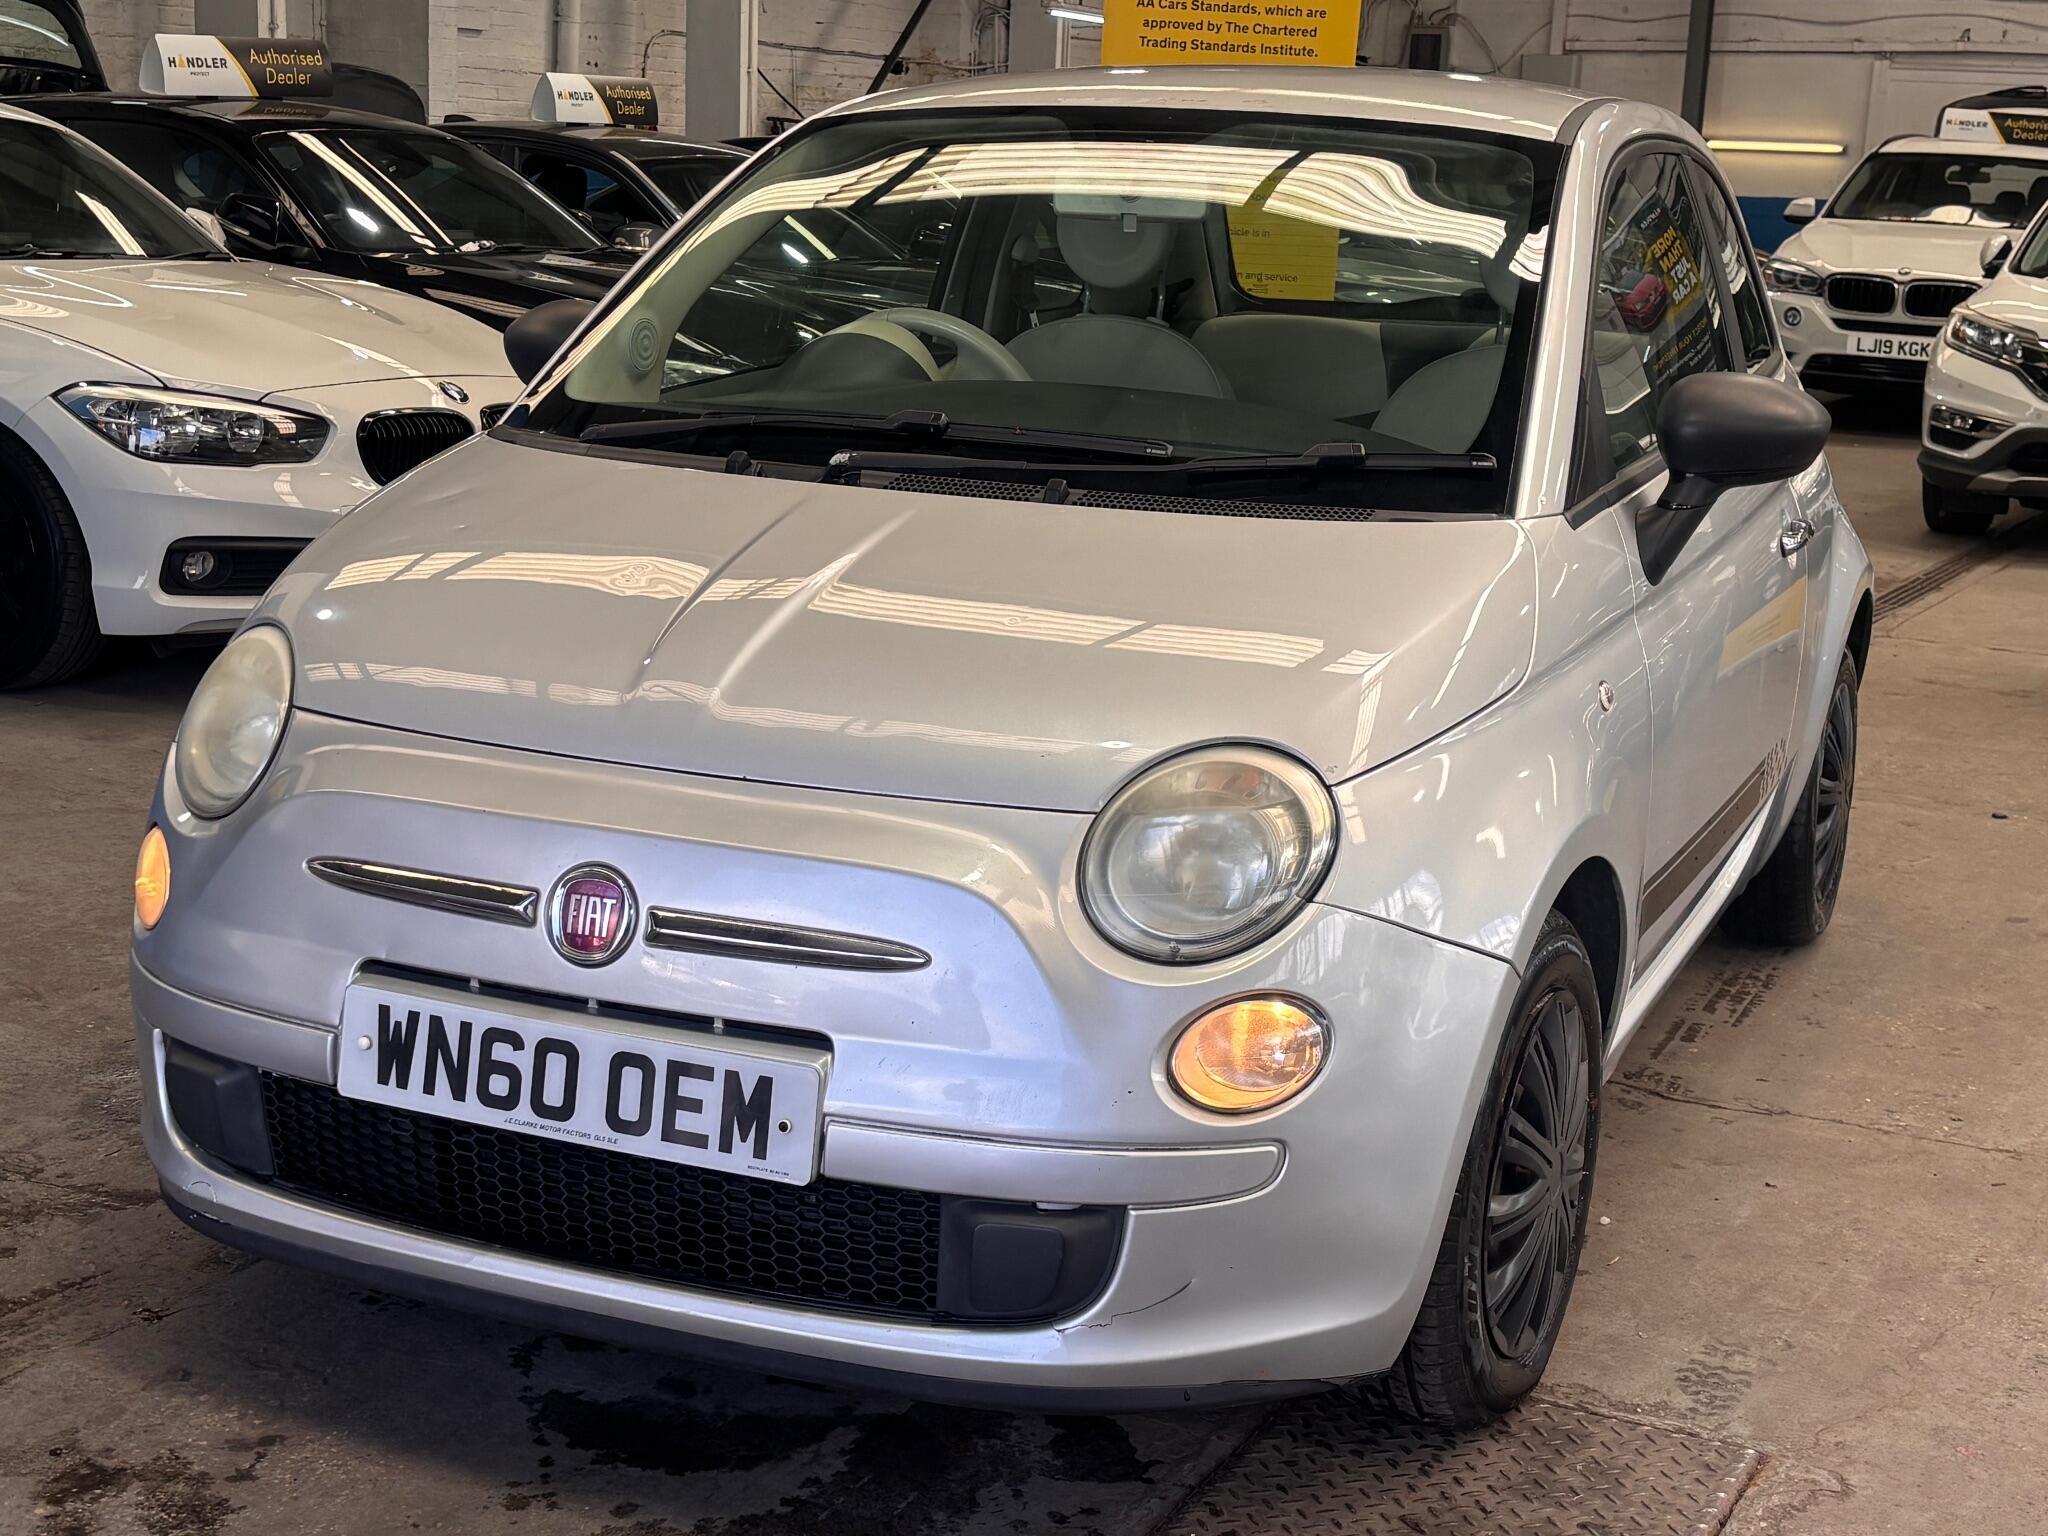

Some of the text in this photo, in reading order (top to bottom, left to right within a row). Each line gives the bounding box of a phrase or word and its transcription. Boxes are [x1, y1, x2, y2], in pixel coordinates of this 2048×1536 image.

[1136, 0, 1327, 19] AA Cars Standards, which are
[1142, 18, 1318, 38] approved by The Chartered
[1139, 35, 1318, 58] Trading Standards Institute.
[250, 48, 323, 66] Authorised
[266, 67, 312, 85] Dealer
[606, 85, 652, 100] Authorised
[617, 101, 645, 115] Dealer
[2004, 118, 2048, 130] Authoris
[1856, 337, 1930, 358] LJ19 KGK
[566, 894, 617, 938] FIAT
[376, 1003, 774, 1161] WN60 OEM
[539, 1124, 561, 1134] MOTOR
[562, 1128, 591, 1140] FACTORS
